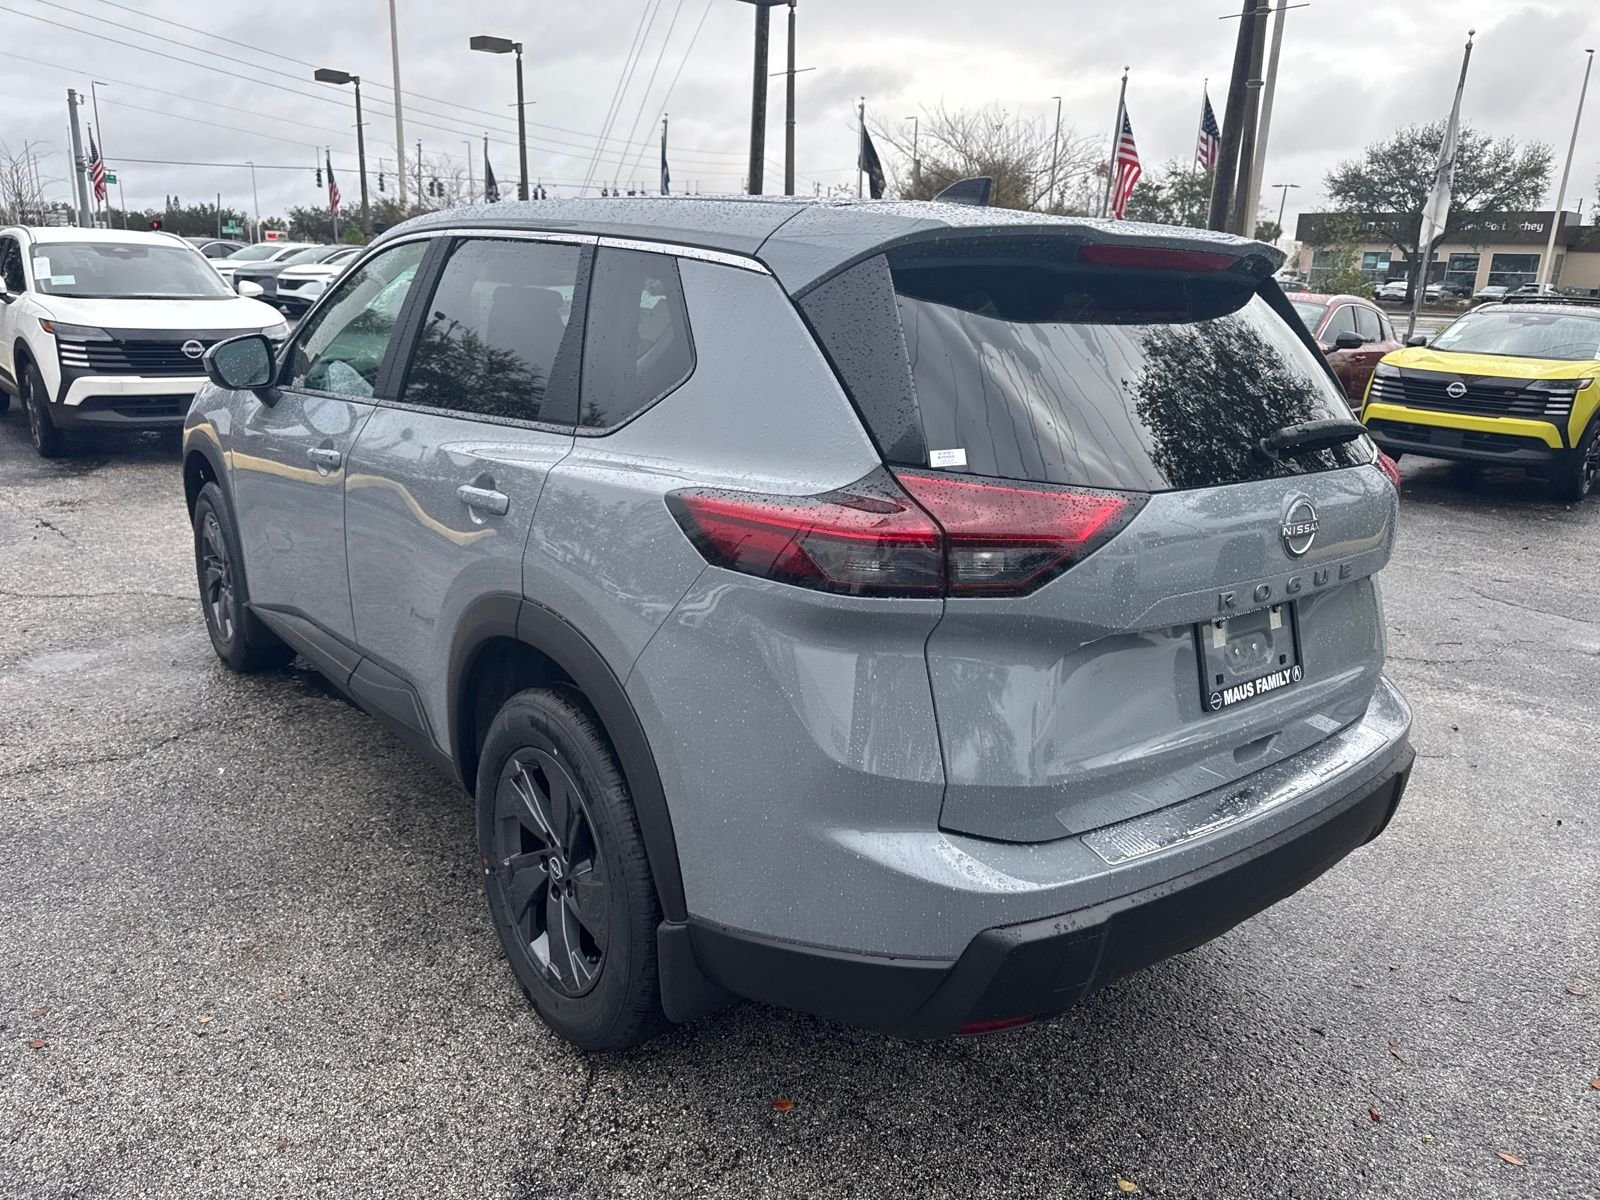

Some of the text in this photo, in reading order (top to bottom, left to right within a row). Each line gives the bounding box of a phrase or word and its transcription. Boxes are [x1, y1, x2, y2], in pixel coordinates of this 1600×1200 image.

[1516, 221, 1544, 233] chey
[1282, 522, 1319, 536] NISSAN
[1218, 562, 1353, 611] ROGUE
[1223, 669, 1291, 706] MAUS FAMILY
